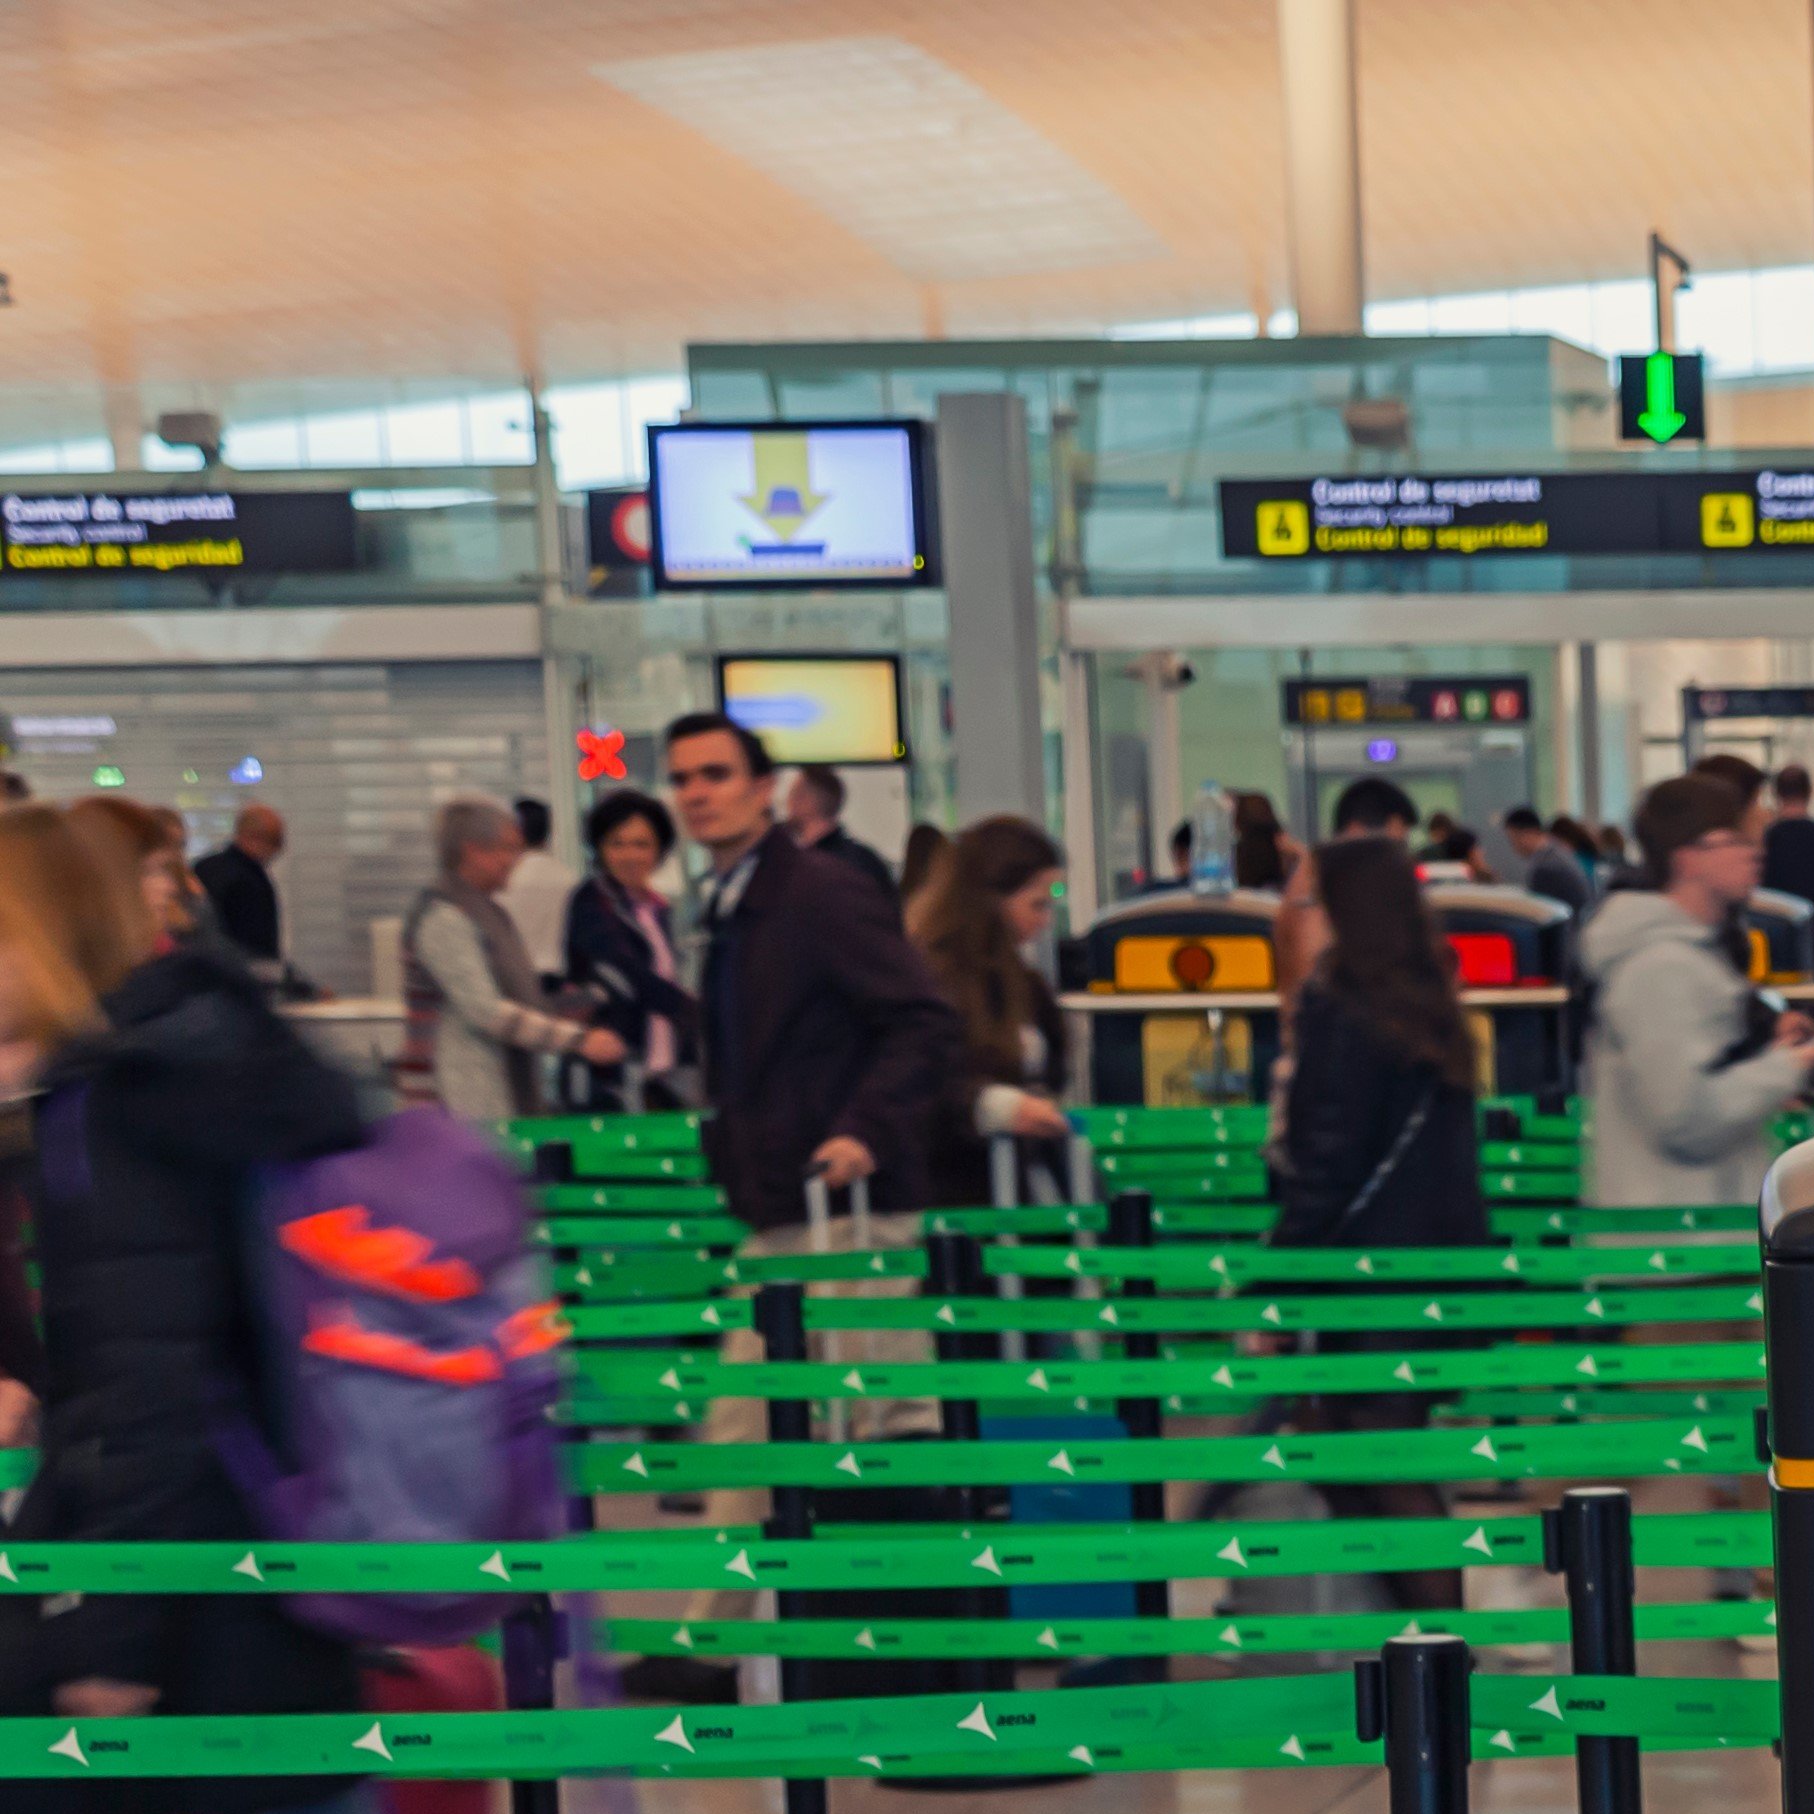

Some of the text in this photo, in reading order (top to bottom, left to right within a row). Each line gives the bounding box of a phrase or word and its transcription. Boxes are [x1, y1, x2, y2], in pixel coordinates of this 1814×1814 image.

[1565, 1699, 1606, 1712] aena
[995, 1713, 1037, 1727] aena
[693, 1727, 734, 1739] aena
[88, 1740, 129, 1753] aena
[392, 1734, 432, 1747] aena
